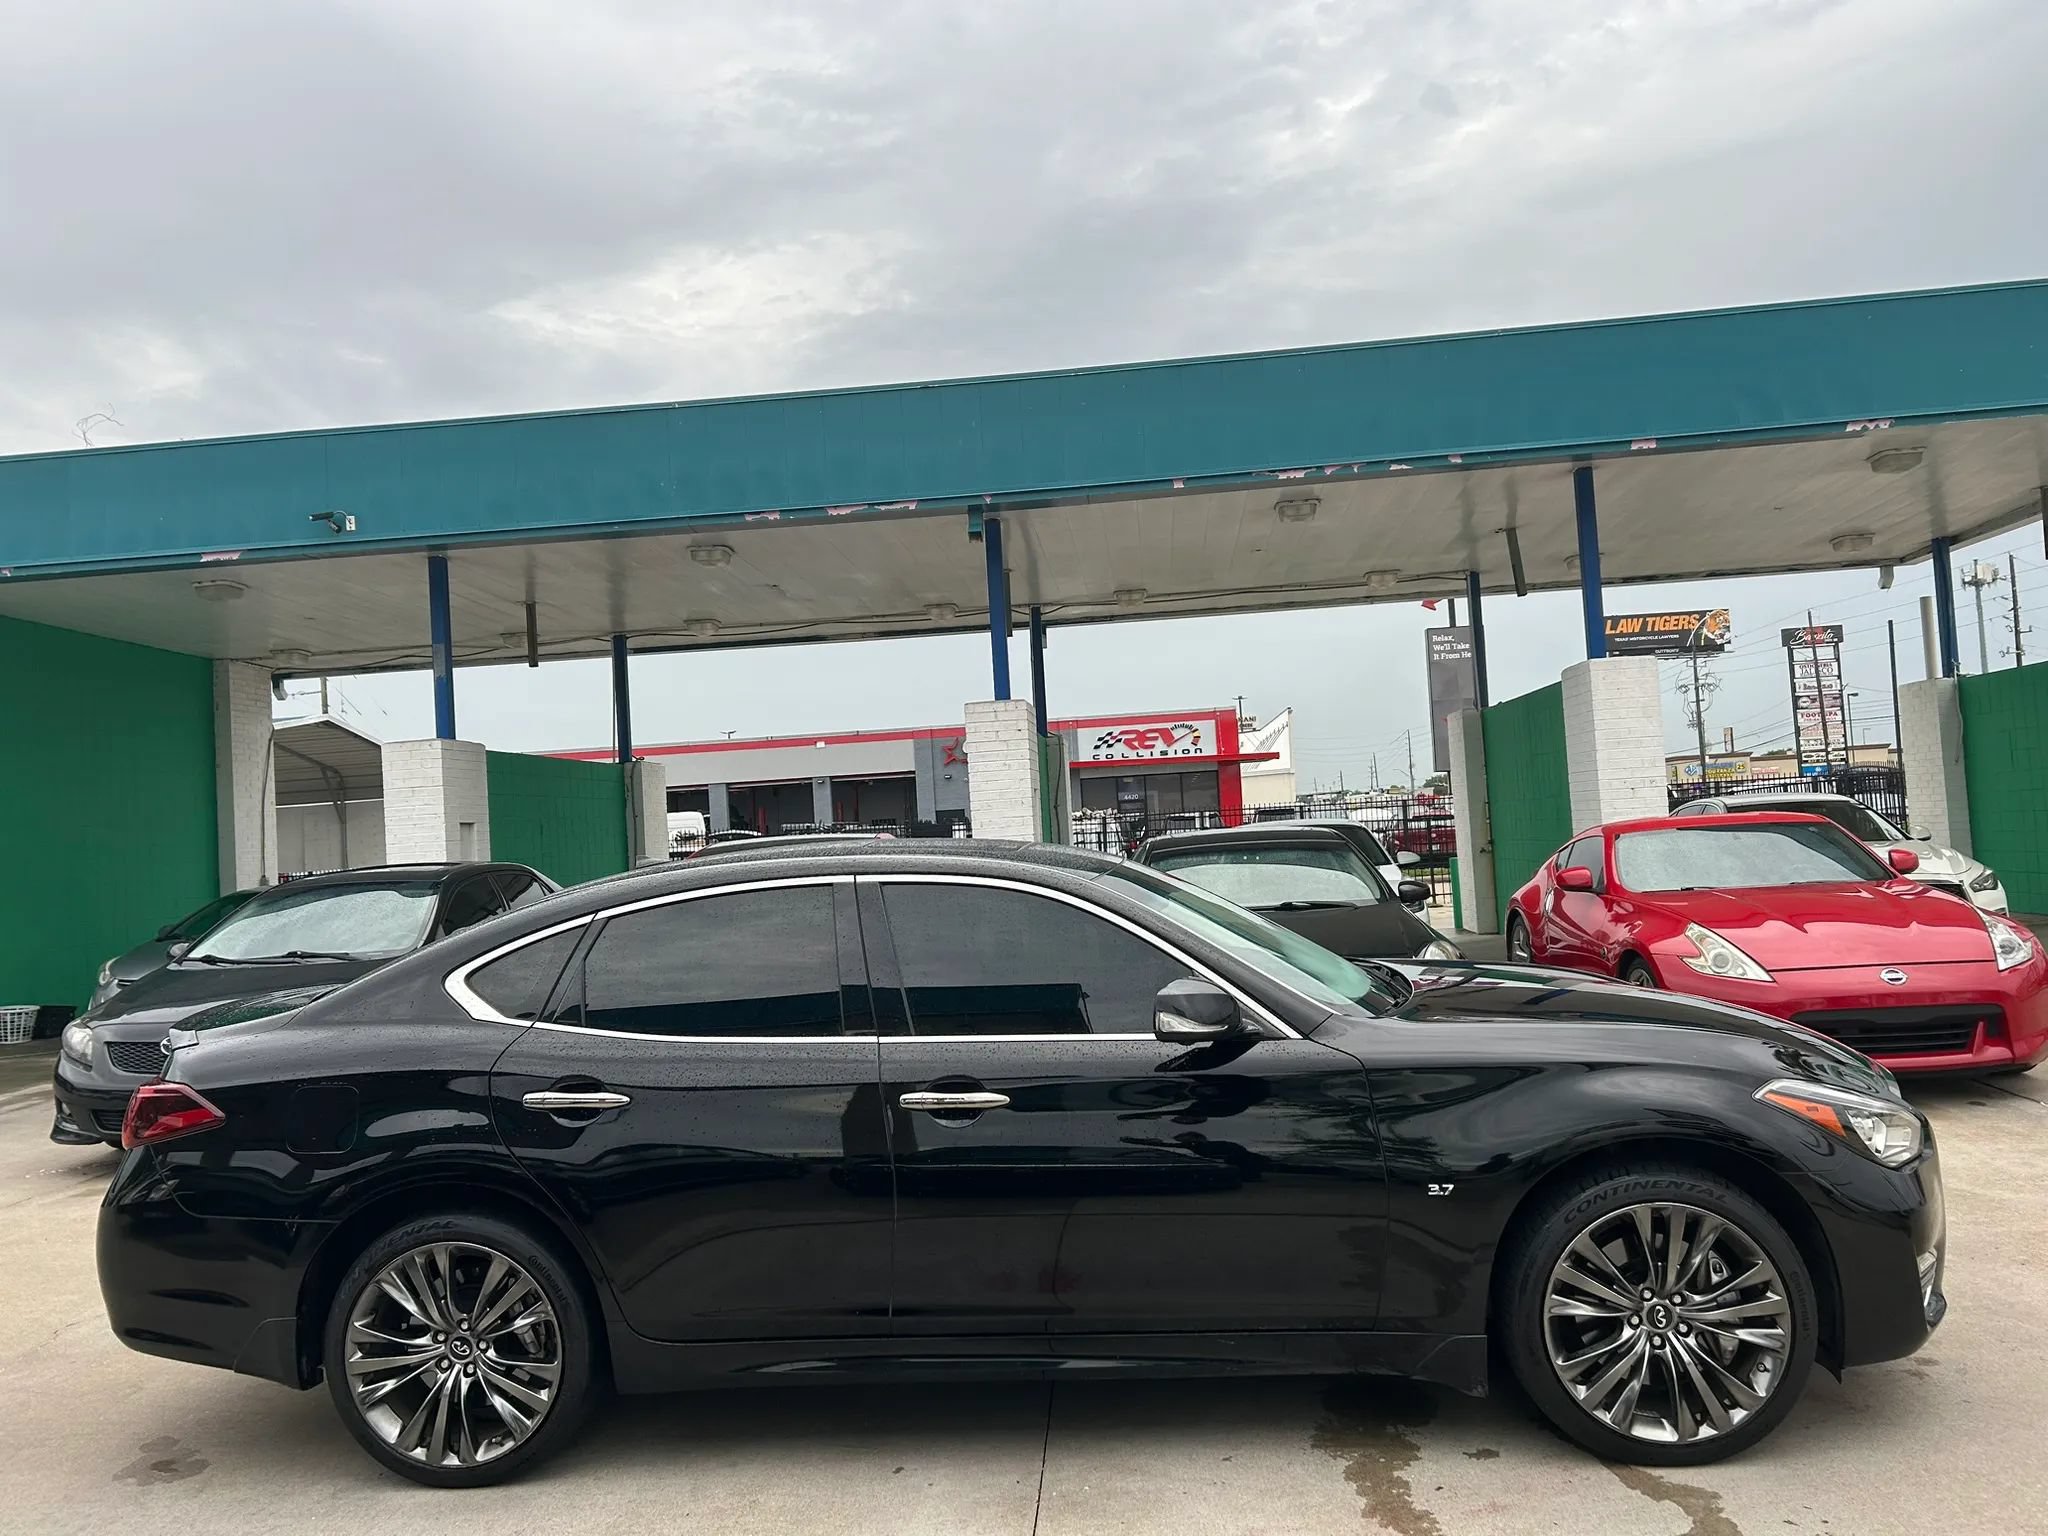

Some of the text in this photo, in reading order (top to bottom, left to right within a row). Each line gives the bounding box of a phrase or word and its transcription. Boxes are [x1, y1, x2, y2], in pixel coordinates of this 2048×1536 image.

[1605, 614, 1700, 634] LAW TIGERS
[1452, 642, 1470, 650] Take
[1441, 652, 1460, 660] From
[1461, 651, 1472, 659] He
[1114, 728, 1186, 751] REV
[1092, 748, 1203, 760] COLLISION
[1428, 1184, 1455, 1196] 3.7
[1563, 1179, 1728, 1225] CONTINENTAL
